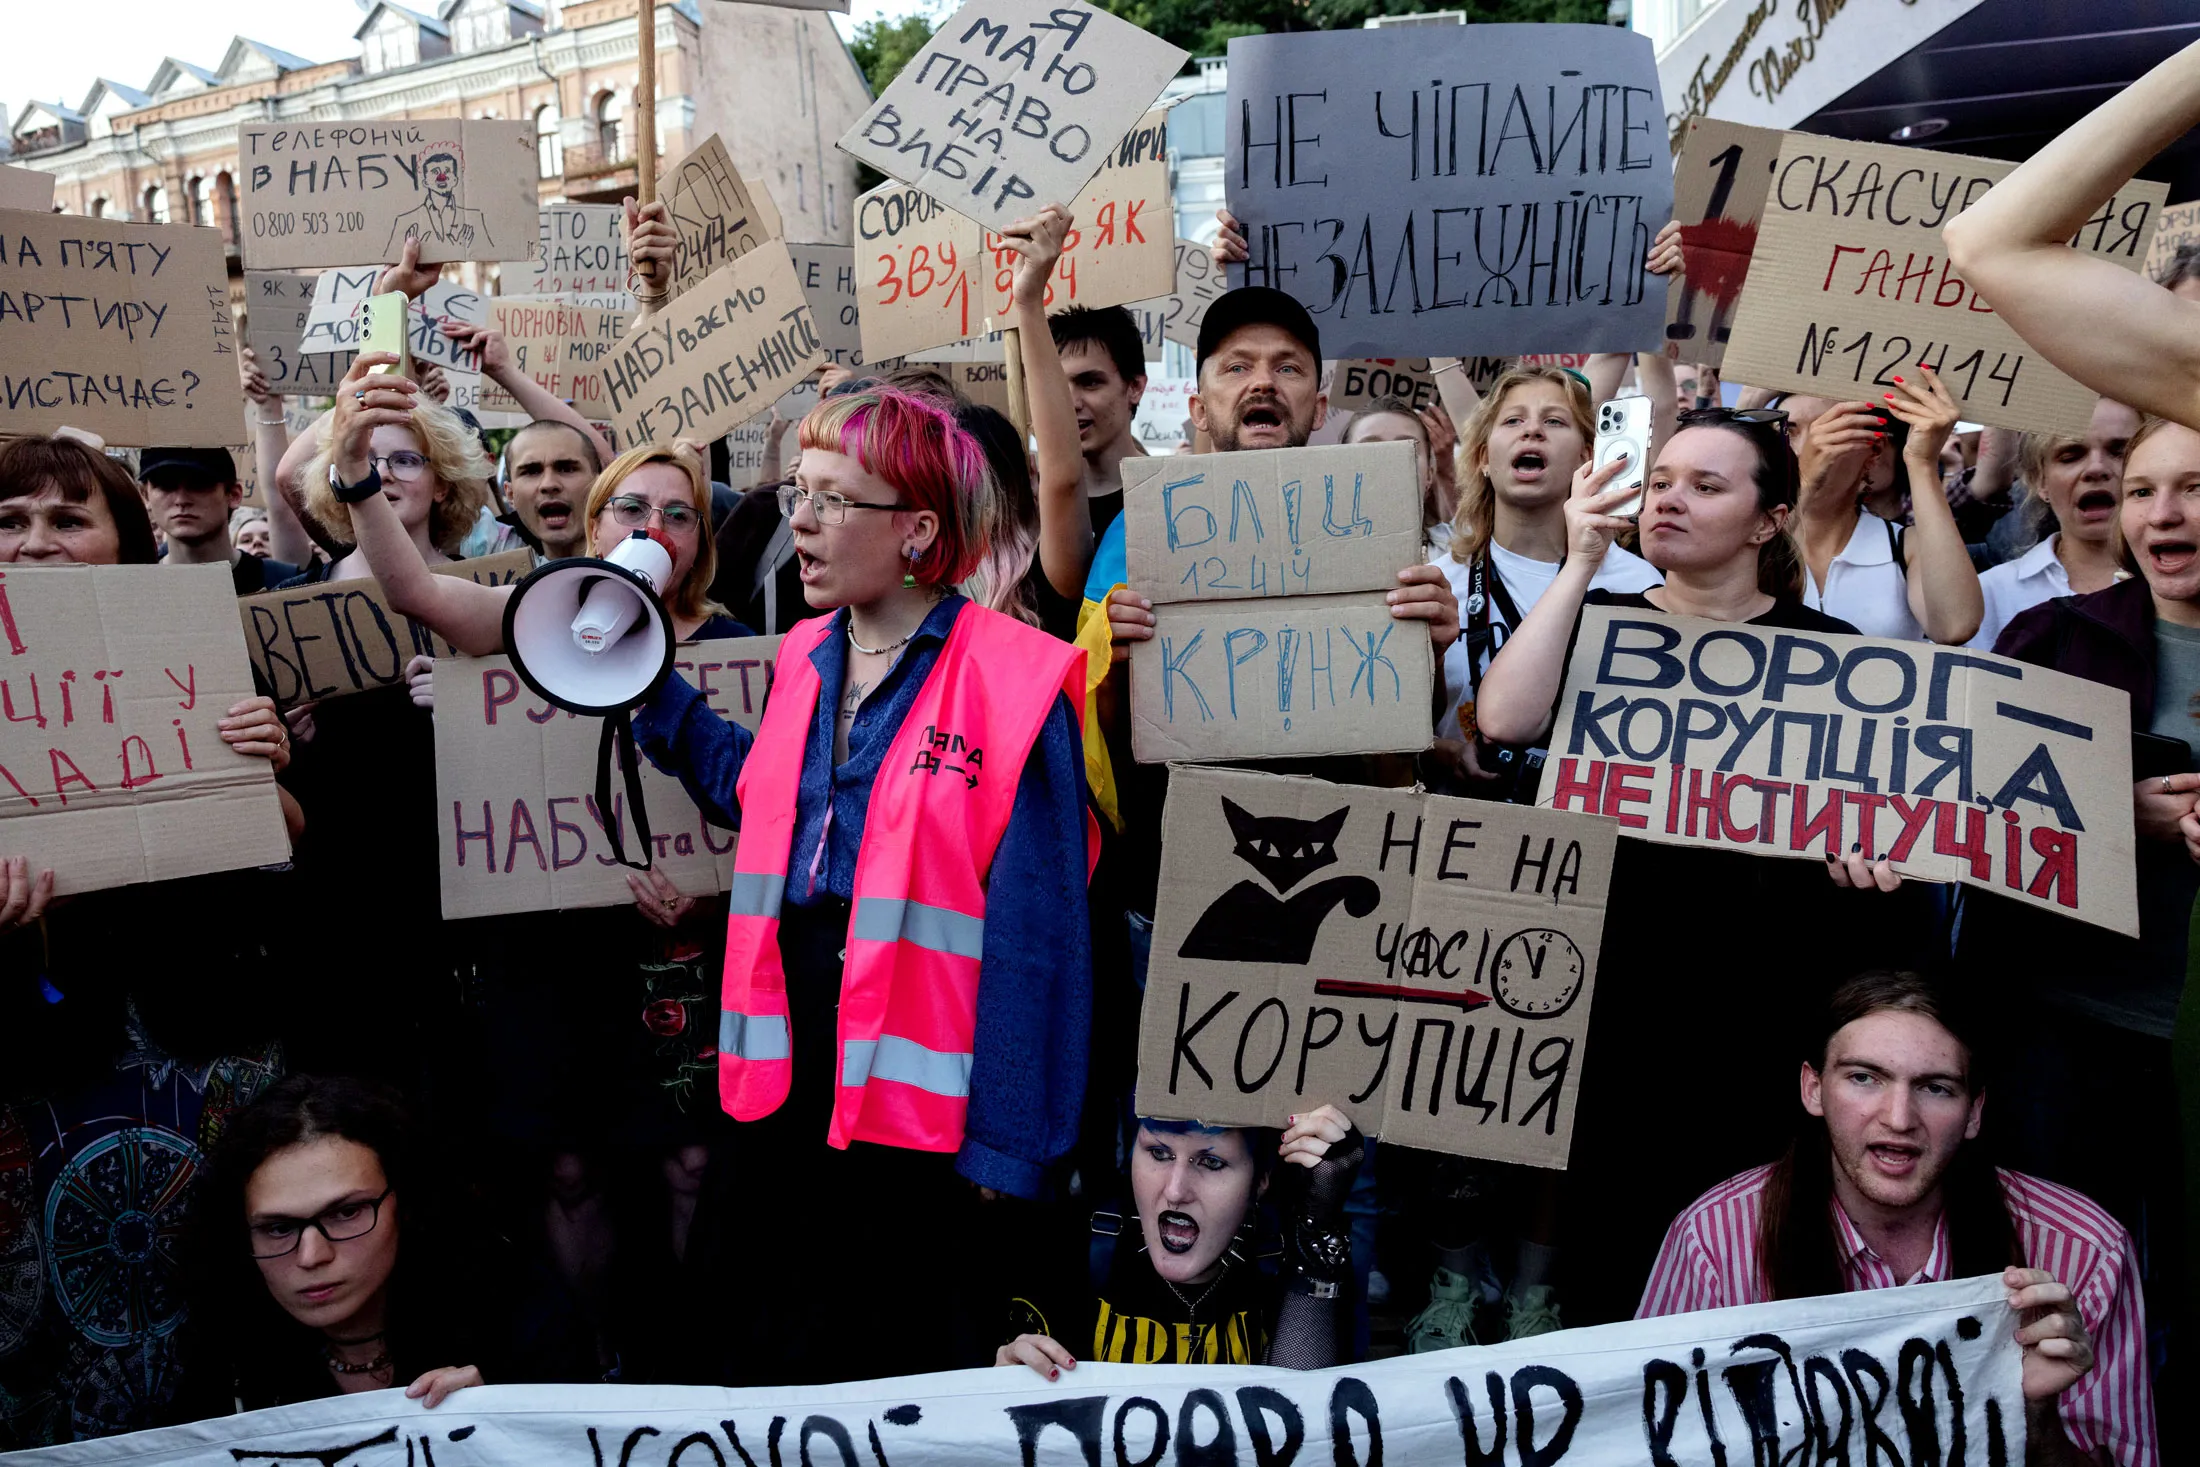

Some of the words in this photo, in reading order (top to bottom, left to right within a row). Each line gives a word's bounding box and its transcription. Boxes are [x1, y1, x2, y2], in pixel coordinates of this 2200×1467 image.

[960, 17, 1098, 95] МАЮ
[1030, 9, 1092, 51] Я
[915, 52, 1092, 164] ПРАВО
[948, 107, 1003, 154] НА
[1241, 89, 1327, 188] НЕ
[252, 164, 273, 193] В
[288, 153, 420, 197] НАБУ
[861, 104, 1035, 212] ВИБІР
[252, 210, 296, 238] 0800
[301, 210, 329, 235] 503
[335, 211, 365, 232] 200
[1094, 198, 1147, 250] ЯК
[599, 313, 625, 339] НЕ
[250, 590, 401, 701] ВЕТО
[1595, 619, 2022, 721] ВОРОГ
[1553, 758, 1655, 828] НЕ
[1378, 810, 1483, 881] НЕ
[1509, 833, 1583, 906] НА
[1168, 982, 1574, 1135] КОРУПЦІЯ
